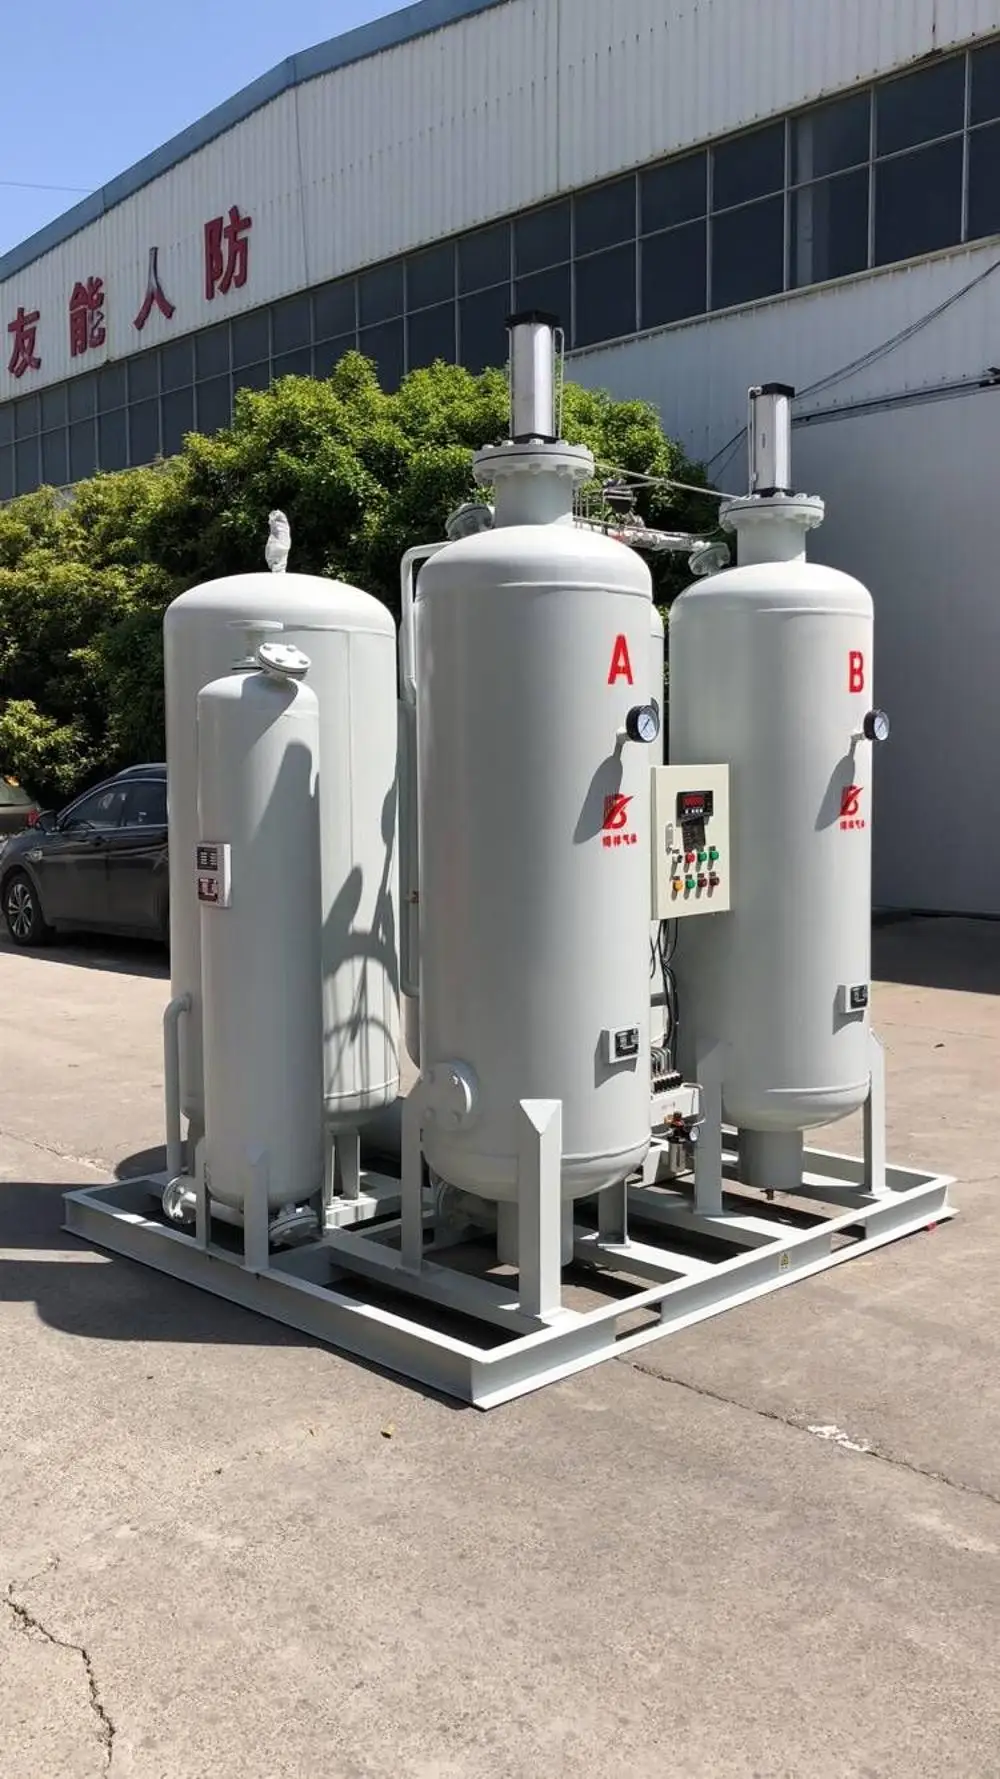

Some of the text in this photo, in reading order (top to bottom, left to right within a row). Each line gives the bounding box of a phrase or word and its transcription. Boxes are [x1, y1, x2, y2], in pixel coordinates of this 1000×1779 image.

[8, 205, 253, 378] 友能人防
[608, 634, 633, 684] A
[849, 651, 864, 692] B
